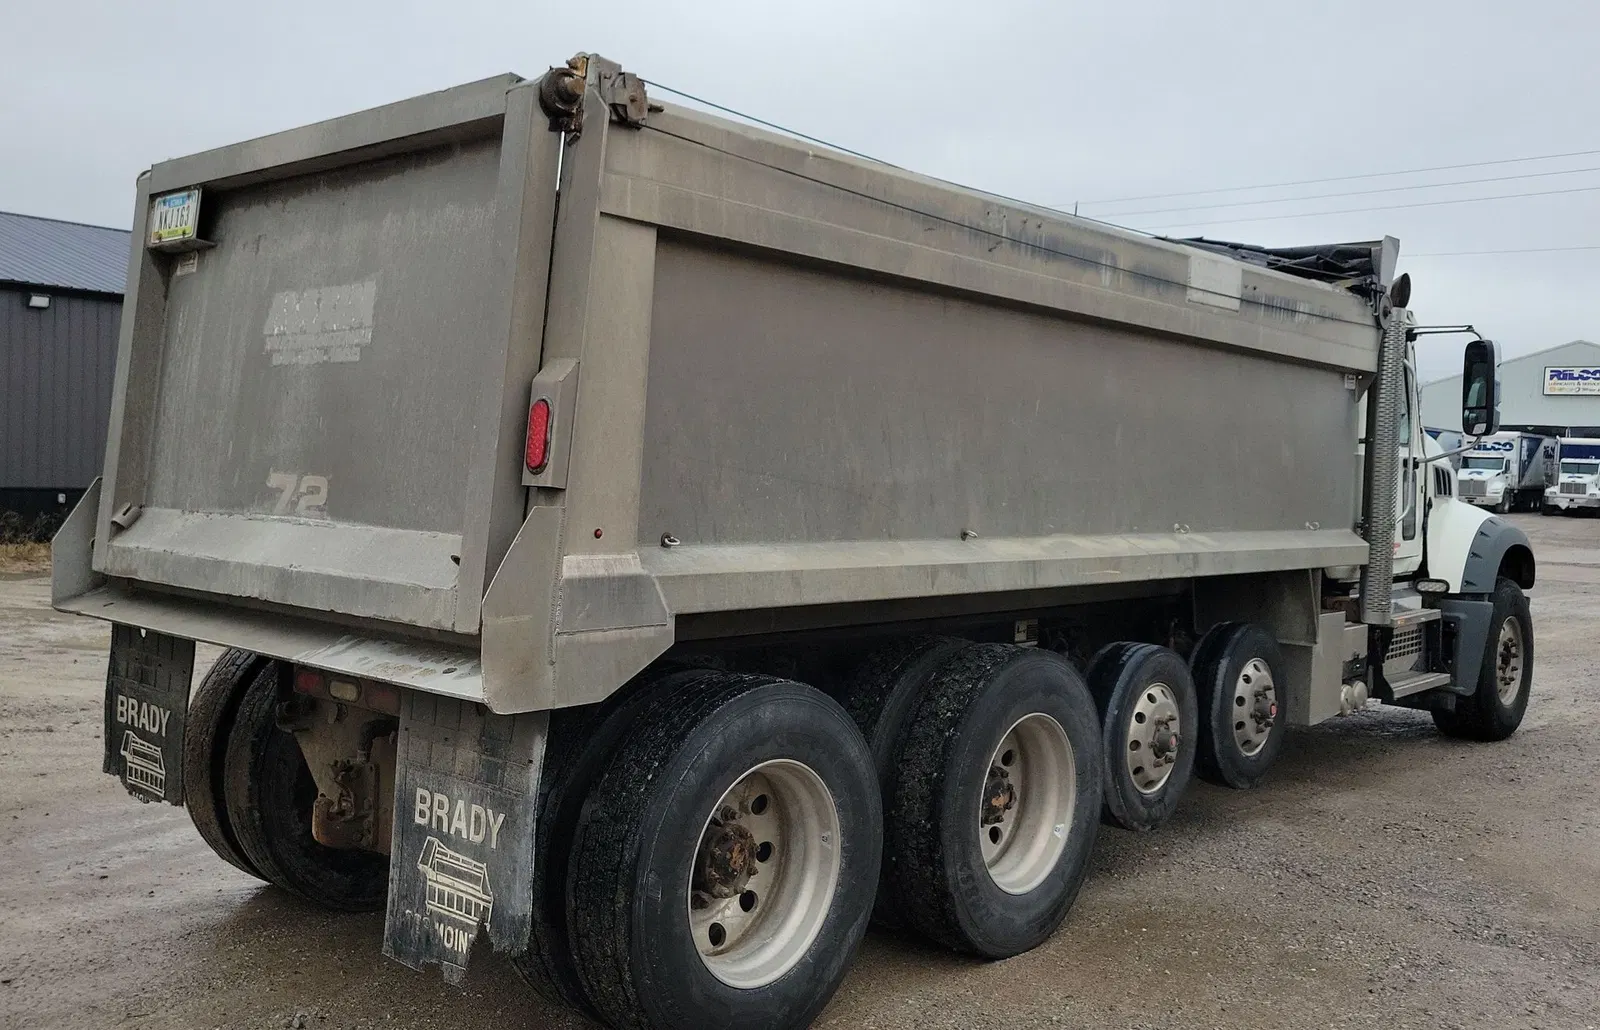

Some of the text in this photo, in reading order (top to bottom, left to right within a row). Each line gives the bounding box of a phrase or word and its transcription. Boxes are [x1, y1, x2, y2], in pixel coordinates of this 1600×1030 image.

[266, 472, 328, 519] 72
[117, 694, 171, 738] BRADY
[414, 787, 505, 850] BRADY
